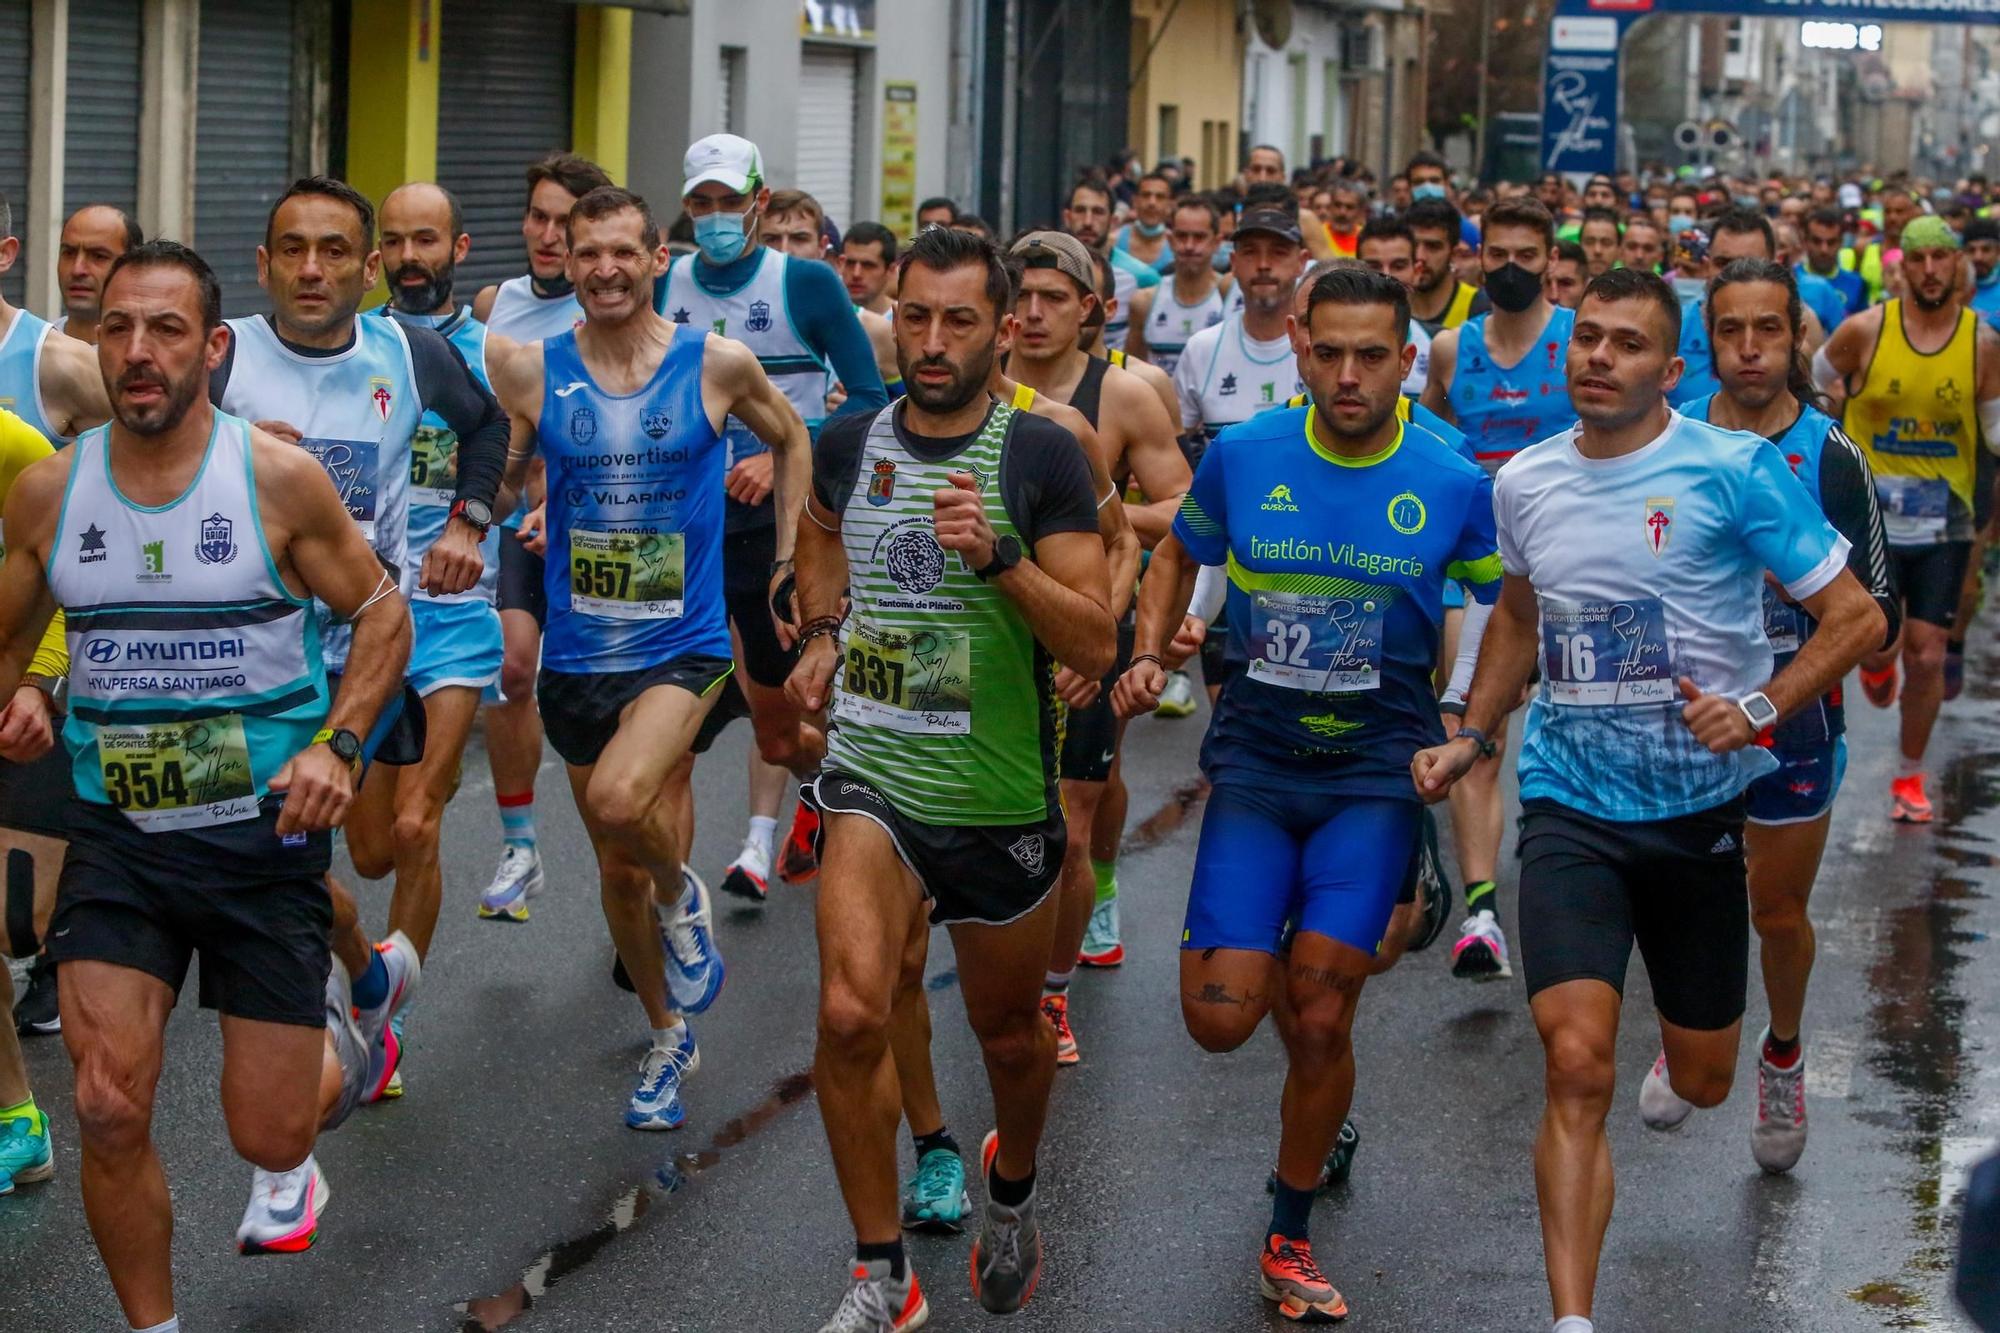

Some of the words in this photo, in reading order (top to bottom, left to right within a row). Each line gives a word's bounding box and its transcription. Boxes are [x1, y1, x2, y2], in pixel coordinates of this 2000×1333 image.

[560, 446, 689, 472] grupovertisol
[79, 552, 107, 564] luanvi
[1251, 535, 1322, 562] triatlón
[1328, 541, 1424, 578] Vilagarcía
[575, 557, 631, 599] 357
[878, 599, 914, 609] Santomé
[916, 601, 928, 610] de
[929, 600, 963, 611] Piñeiro
[1267, 601, 1327, 615] PONTECESURES
[1327, 599, 1358, 635] Run
[1609, 603, 1641, 642] Run
[127, 639, 245, 661] HYUNDAI
[908, 633, 942, 671] Run
[1266, 619, 1311, 668] 32
[1555, 634, 1596, 681] 16
[88, 677, 159, 691] HYUPERSA
[162, 674, 246, 691] SANTIAGO
[848, 647, 904, 705] 337
[1613, 640, 1658, 692] them
[1631, 684, 1665, 698] Palma
[926, 714, 961, 728] Palma
[105, 761, 188, 809] 354
[212, 803, 249, 819] Palma
